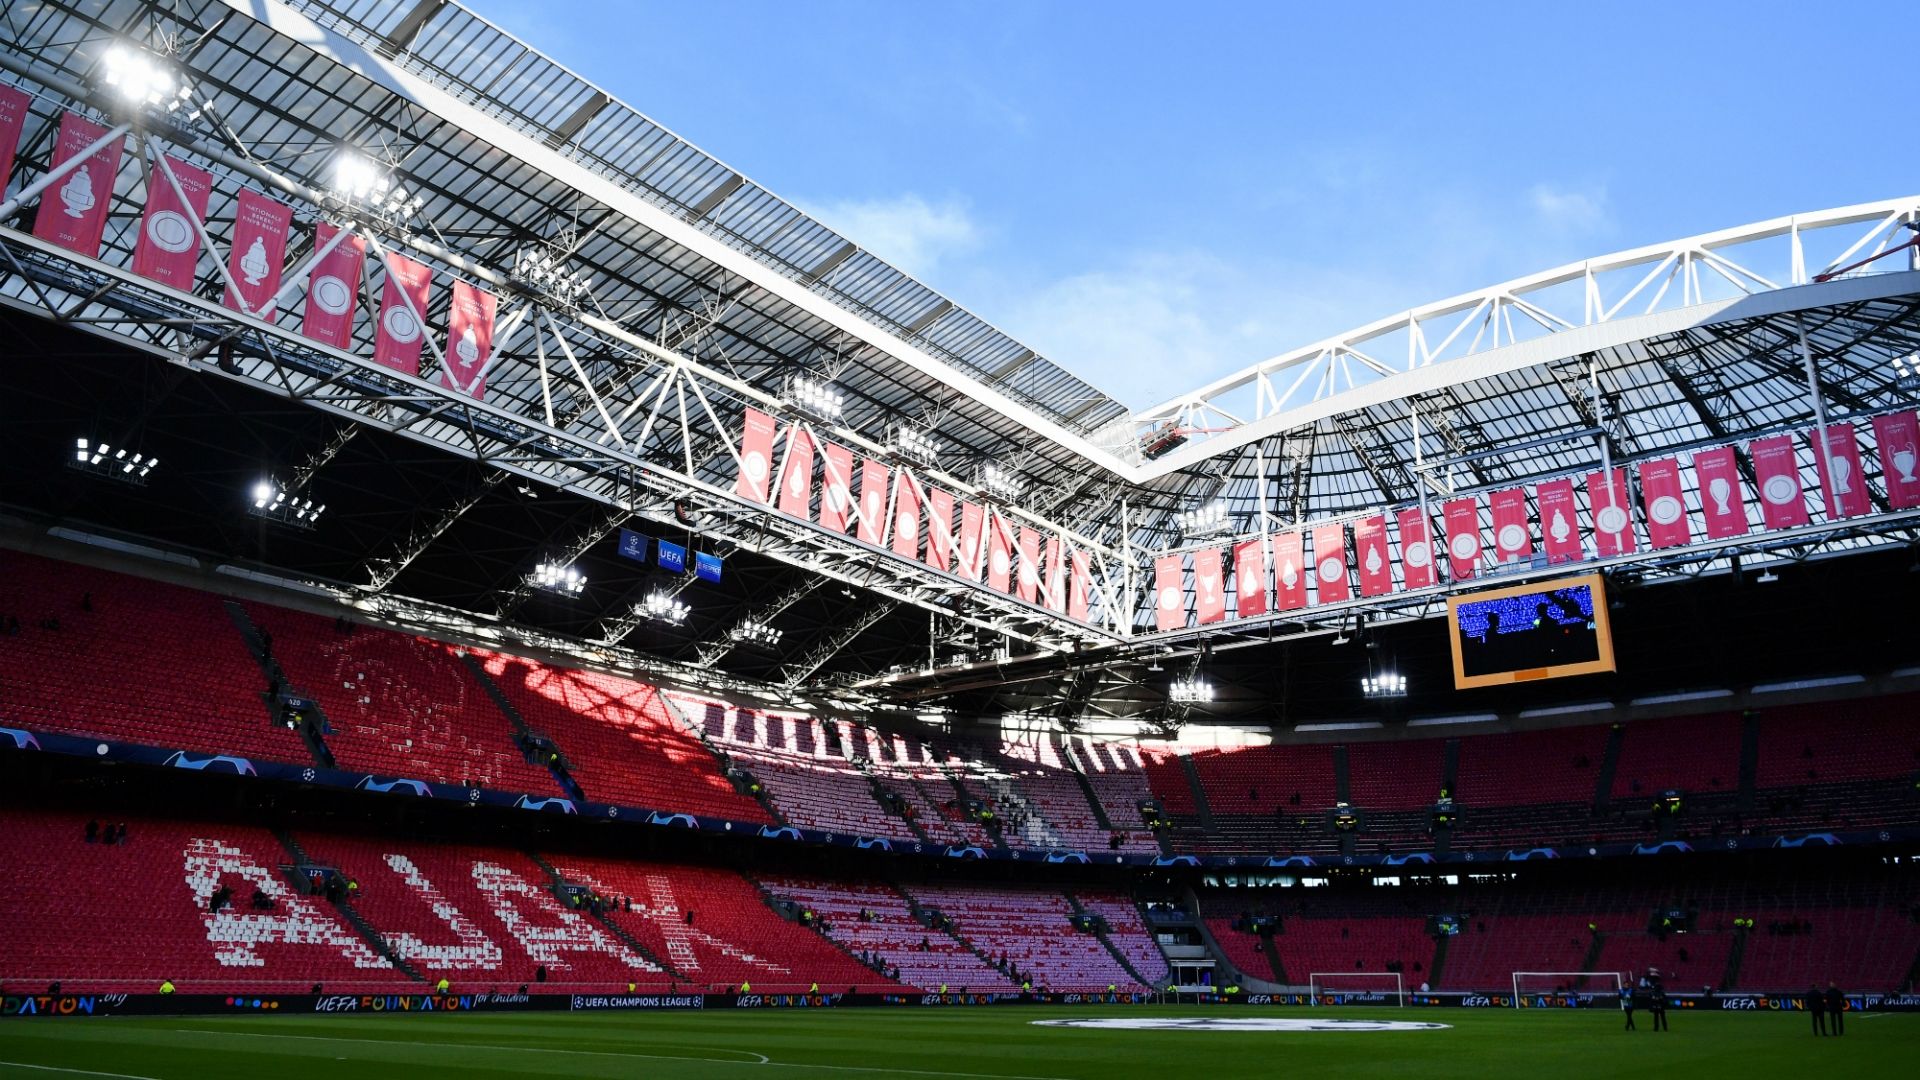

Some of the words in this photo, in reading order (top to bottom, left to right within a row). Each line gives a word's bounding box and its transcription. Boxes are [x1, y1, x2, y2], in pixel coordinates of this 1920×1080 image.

[245, 203, 283, 222] NATIONALE
[58, 232, 77, 243] 2007
[659, 548, 682, 565] UEFA
[184, 838, 793, 974] AJAX
[0, 997, 95, 1013] DATION
[315, 996, 358, 1011] UEFA
[361, 995, 470, 1011] FOUNDATION
[473, 993, 489, 1008] for
[491, 993, 529, 1003] children
[585, 997, 608, 1007] UEFA
[610, 997, 659, 1007] CHAMPIONS
[661, 997, 691, 1007] LEAGUE
[737, 995, 761, 1007] UEFA
[764, 995, 830, 1007] FOUNDATION
[921, 994, 940, 1005] UEFA
[1064, 994, 1081, 1004] UEFA
[1082, 994, 1139, 1004] FOUNATION
[1248, 994, 1271, 1004] UEFA
[1462, 996, 1490, 1007] UEFA
[1722, 998, 1756, 1009] UEFA
[1759, 998, 1863, 1010] FOUNON
[1866, 997, 1879, 1009] for
